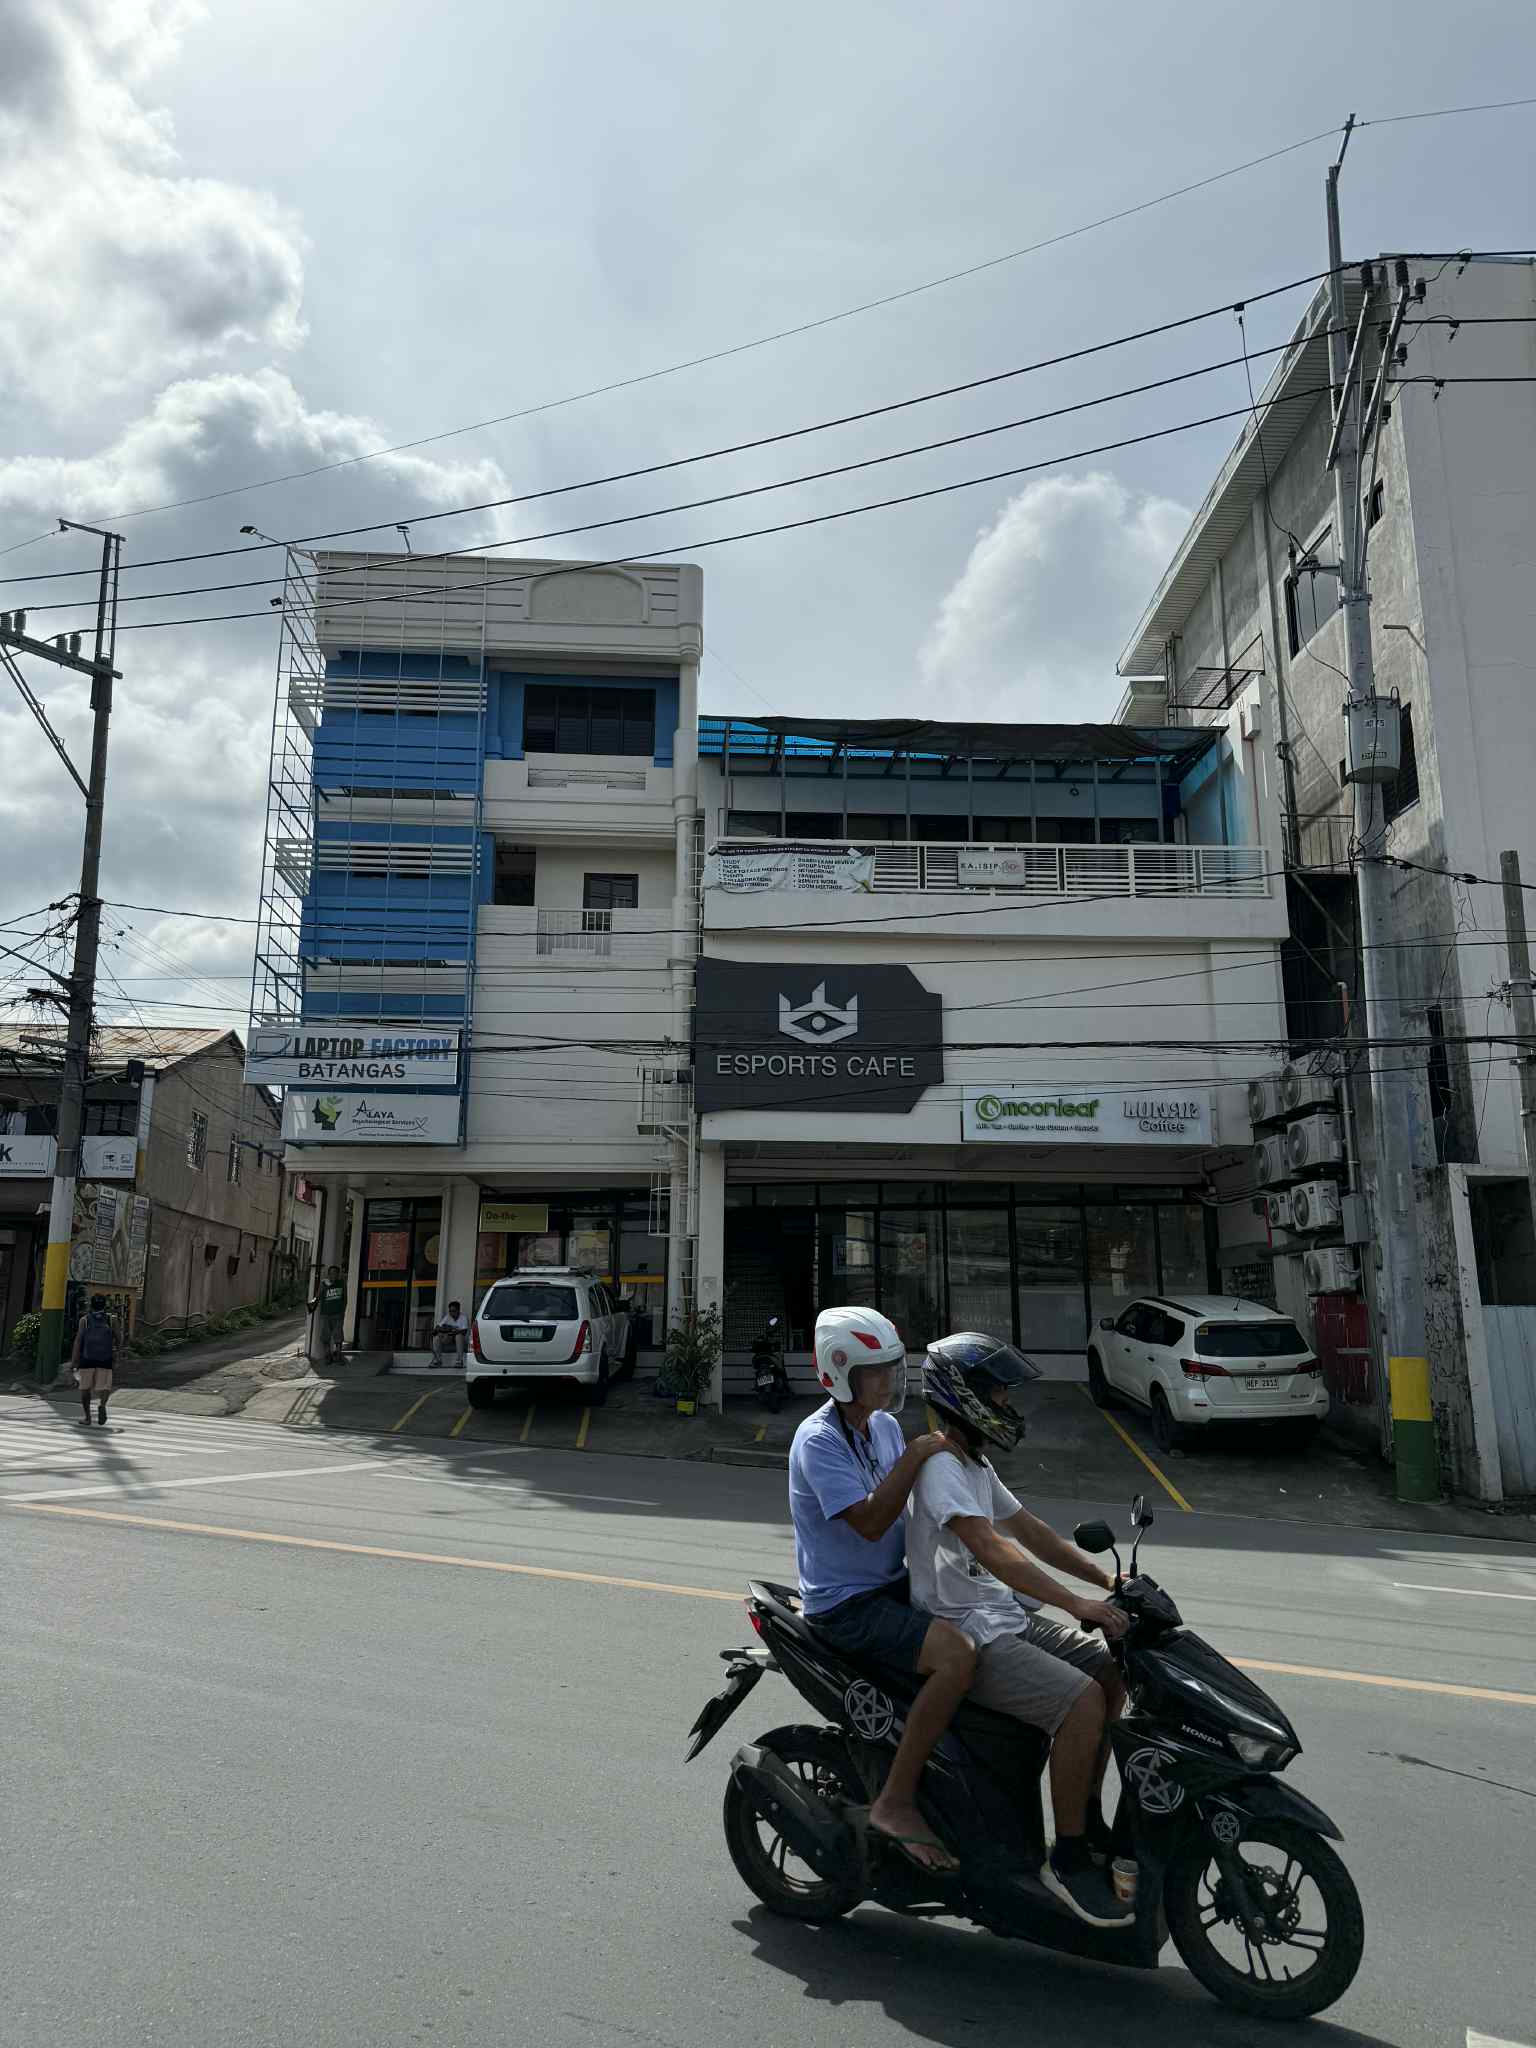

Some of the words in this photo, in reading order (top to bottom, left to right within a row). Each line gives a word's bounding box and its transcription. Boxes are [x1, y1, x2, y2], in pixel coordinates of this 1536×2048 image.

[294, 1037, 365, 1058] LAPTOP
[369, 1038, 453, 1060] FACTORY
[299, 1062, 406, 1079] BATANGAS
[716, 1055, 837, 1076] ESPORTS
[847, 1056, 916, 1077] CAFE
[1002, 1098, 1099, 1119] moonleaf
[1138, 1118, 1185, 1133] Coffee
[1181, 1723, 1224, 1748] HONDA
